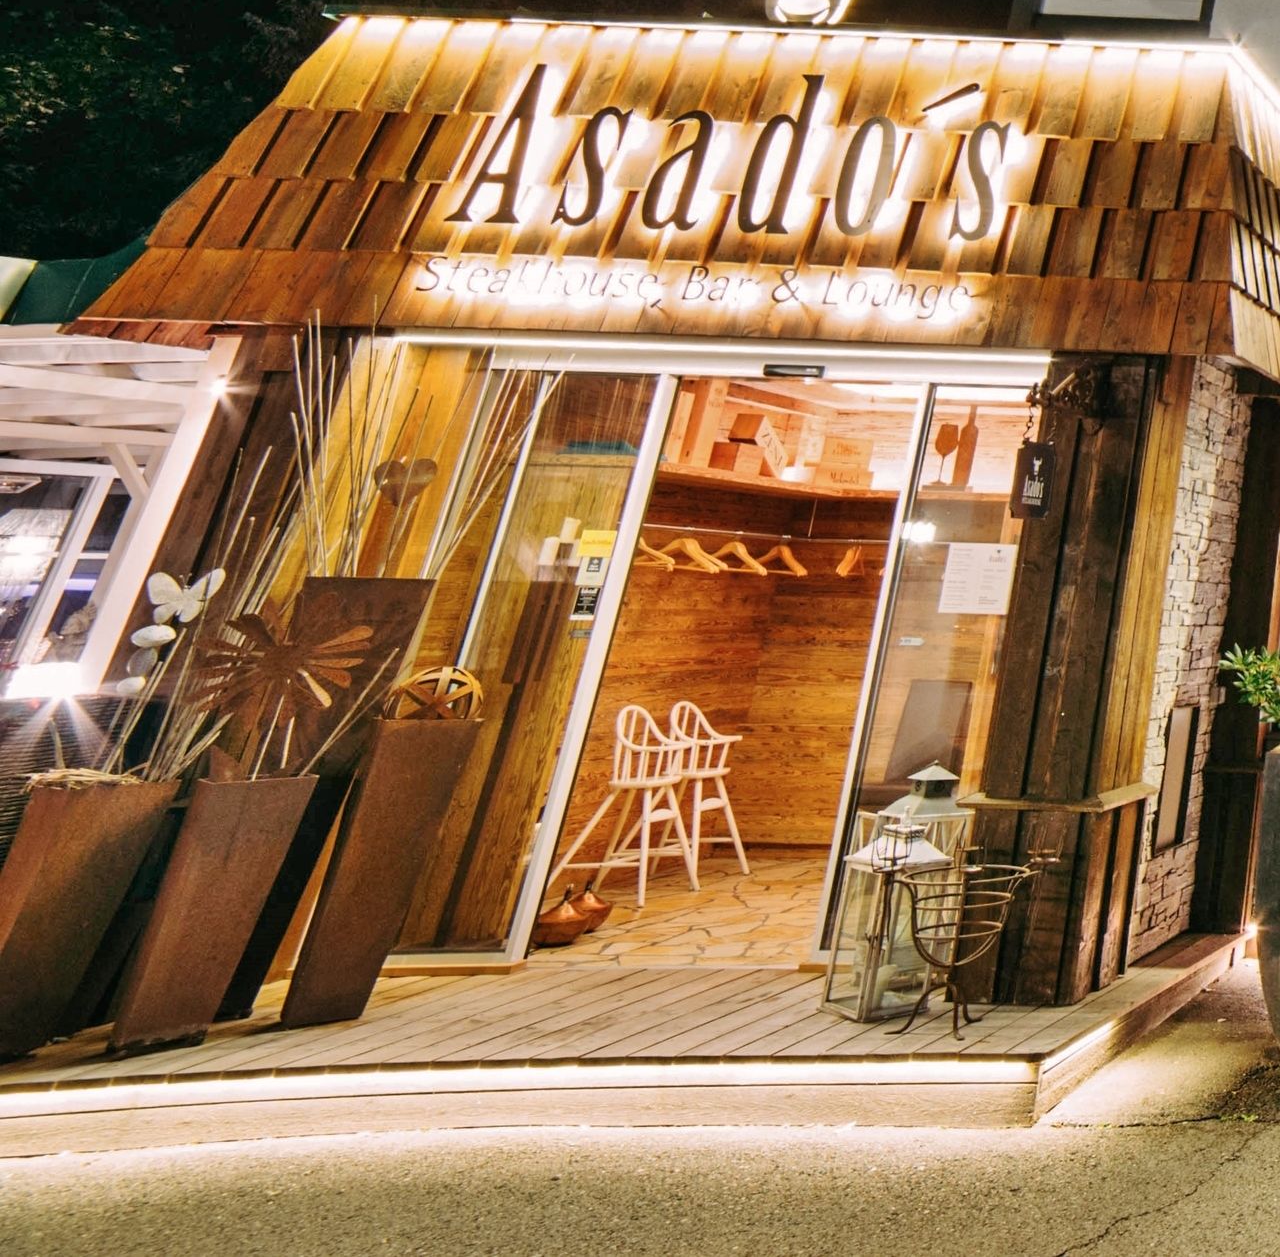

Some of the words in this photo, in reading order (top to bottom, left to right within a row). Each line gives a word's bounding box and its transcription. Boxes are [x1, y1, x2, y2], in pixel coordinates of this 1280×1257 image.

[682, 265, 757, 302] Bar
[772, 268, 800, 304] &
[822, 269, 974, 320] Lounge
